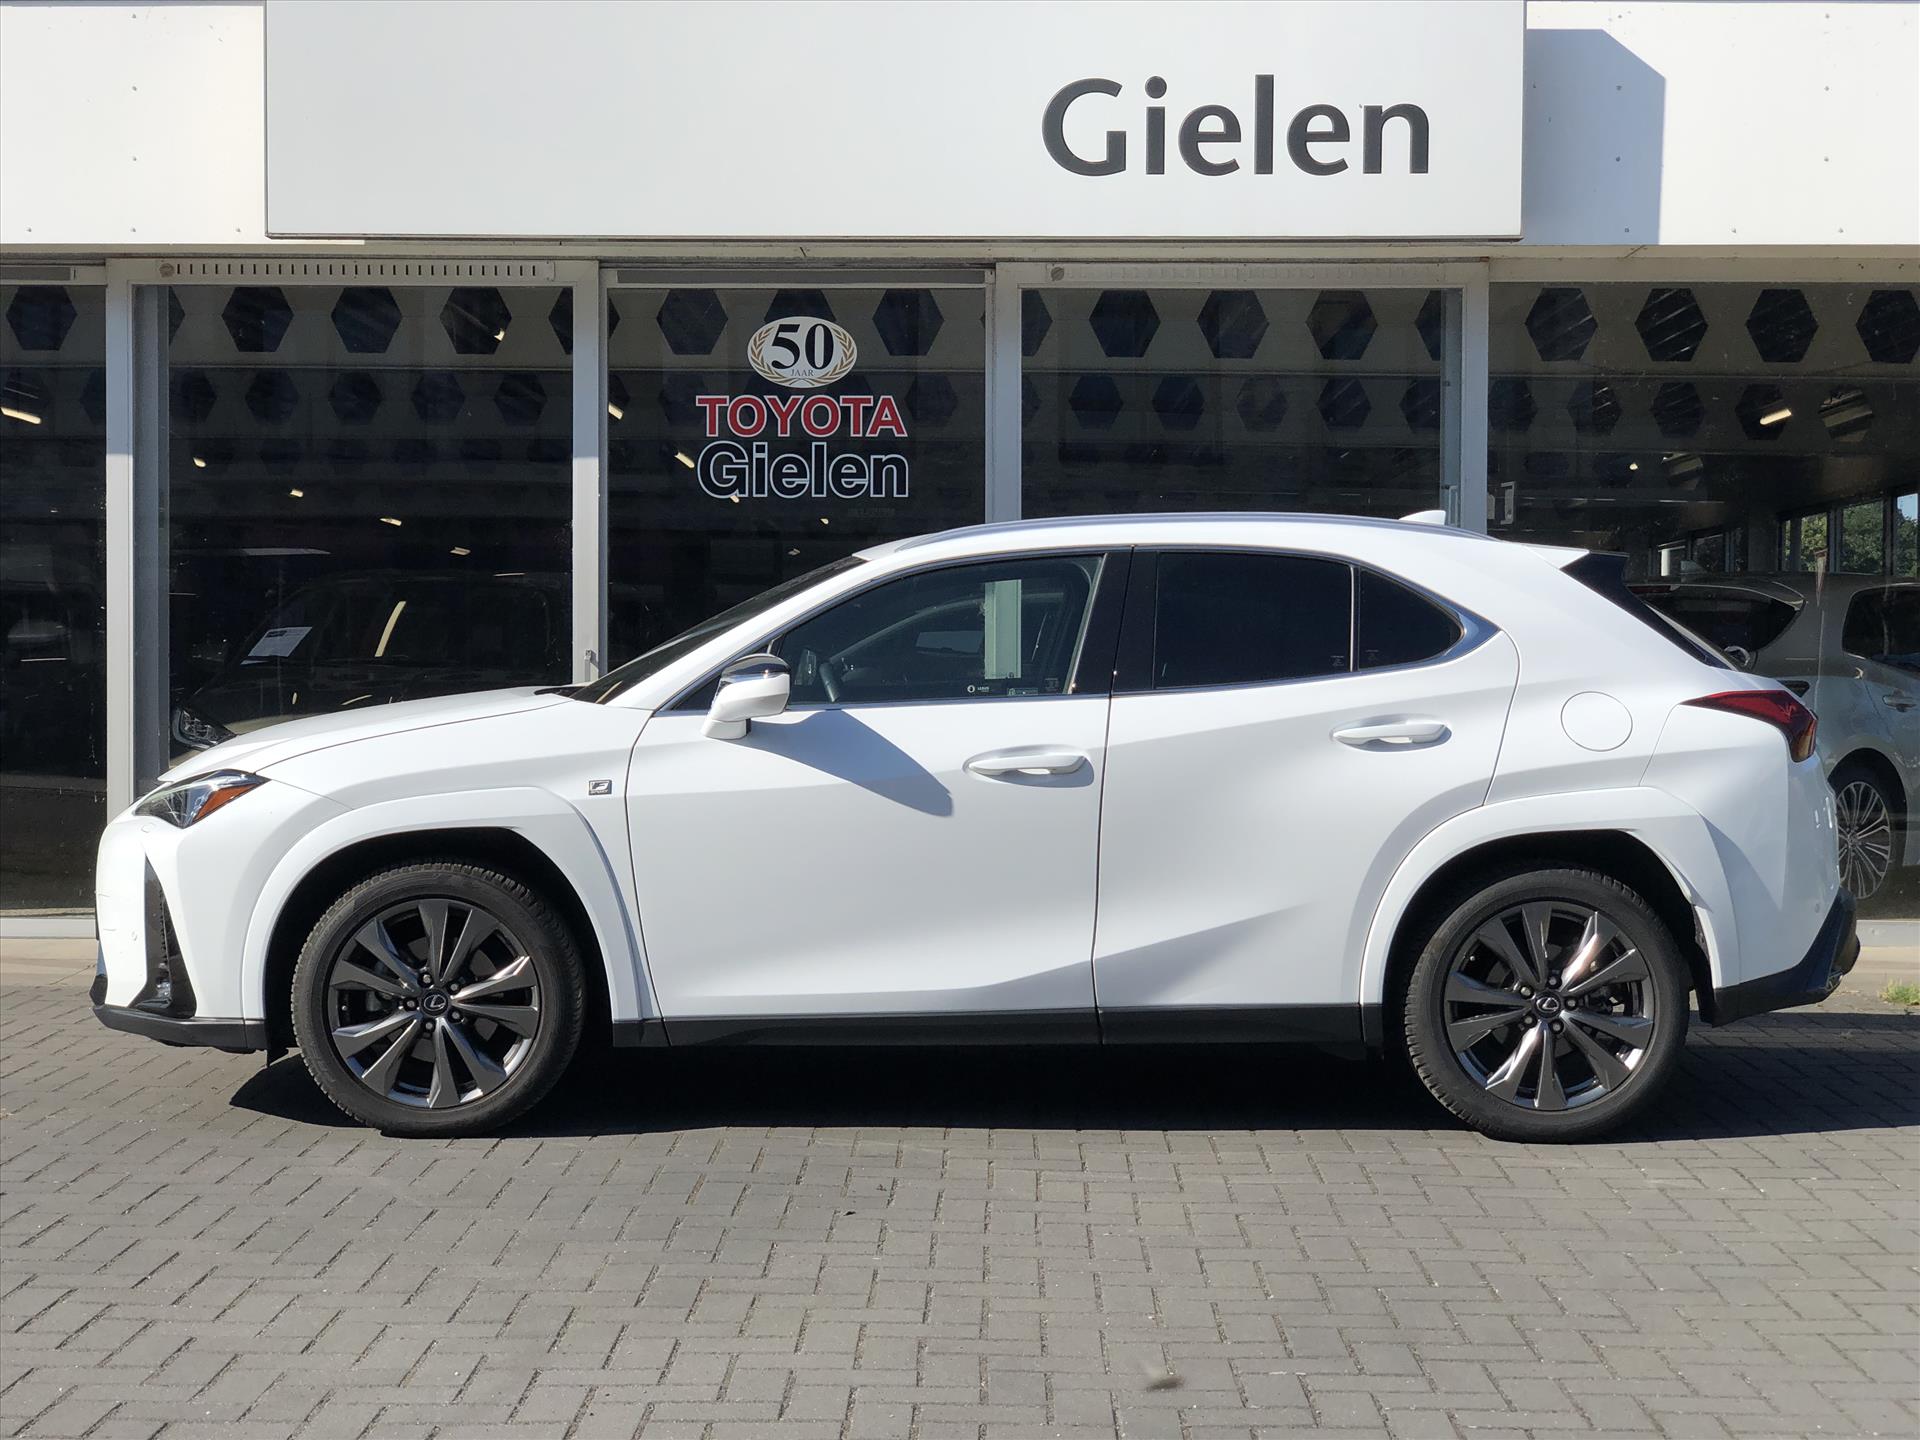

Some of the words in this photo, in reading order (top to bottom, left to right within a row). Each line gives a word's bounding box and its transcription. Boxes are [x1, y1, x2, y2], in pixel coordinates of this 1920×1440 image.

[1042, 74, 1430, 177] Gielen
[771, 323, 834, 370] 50
[790, 369, 814, 377] JAAR
[696, 395, 908, 437] TOYOTA
[697, 440, 909, 498] Gielen
